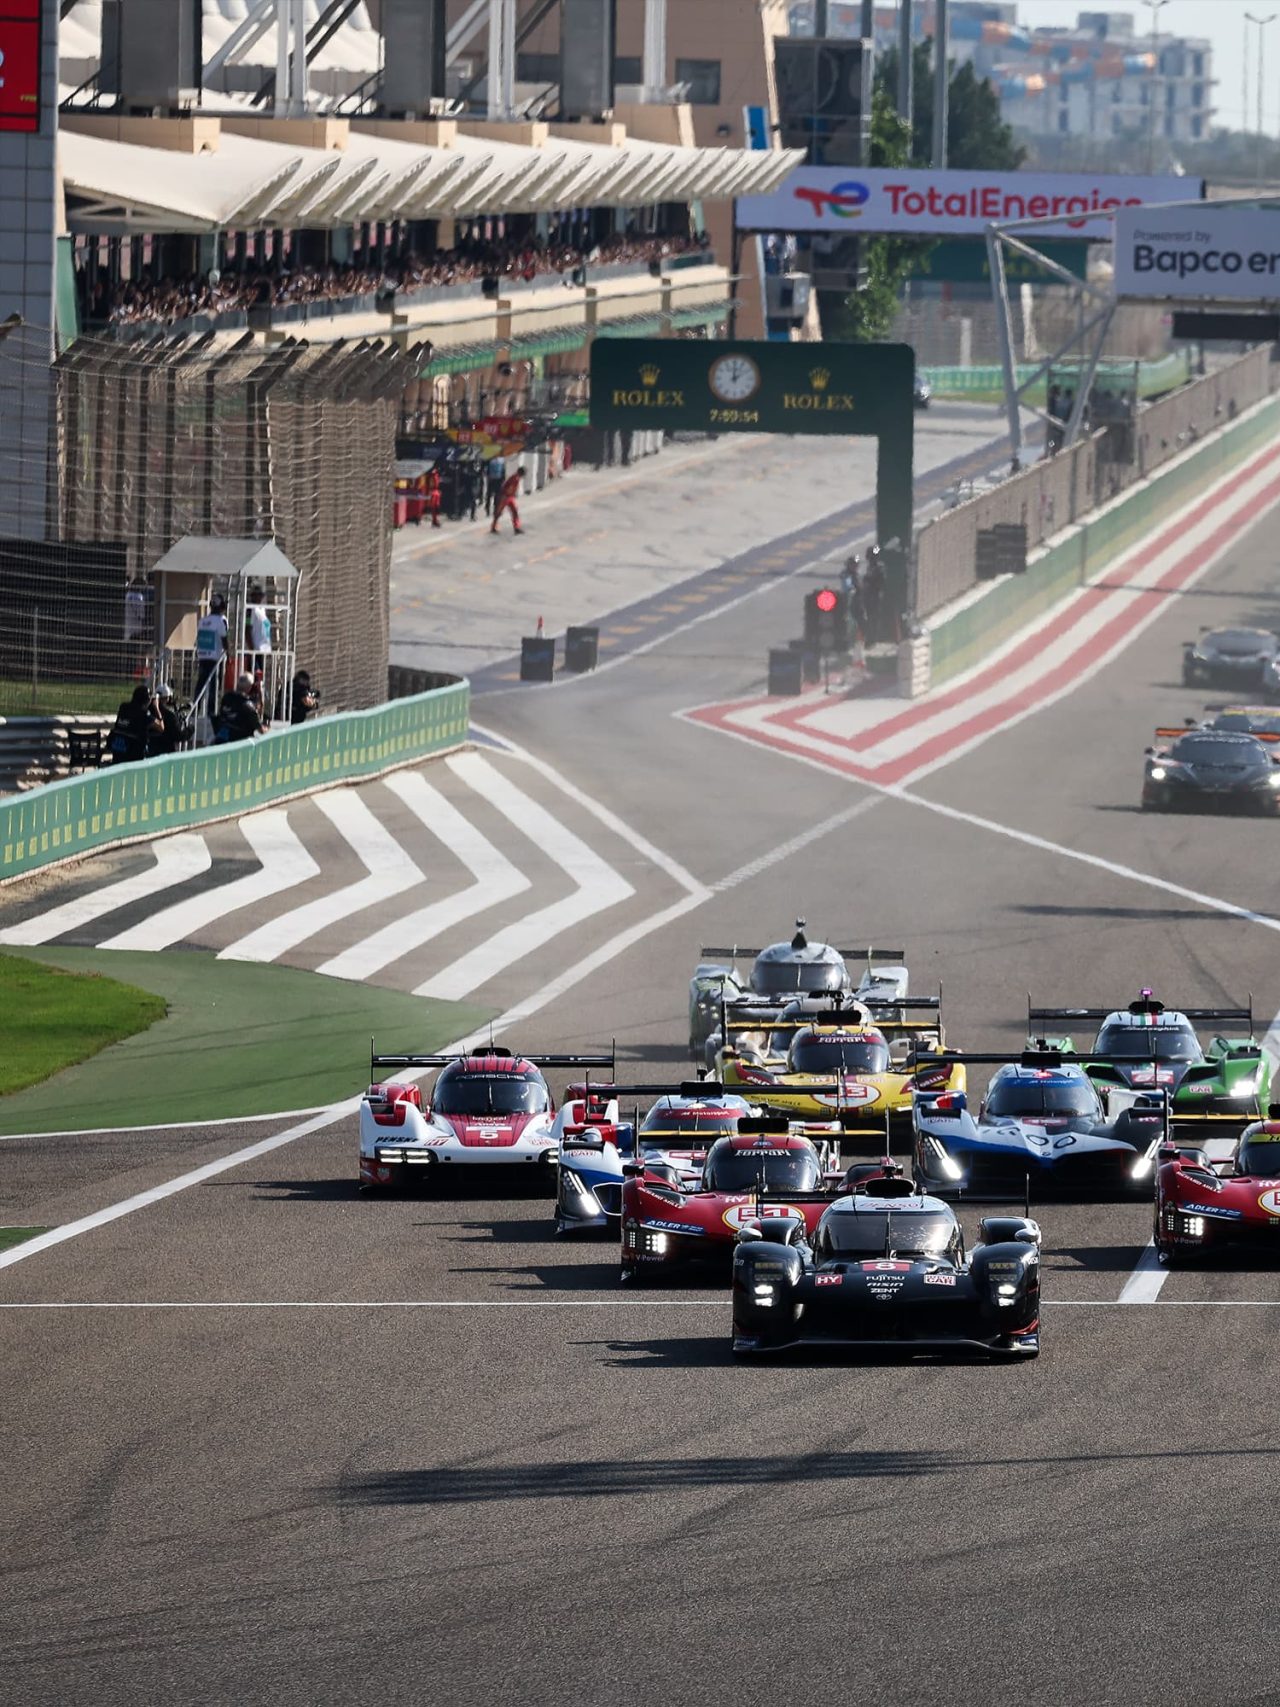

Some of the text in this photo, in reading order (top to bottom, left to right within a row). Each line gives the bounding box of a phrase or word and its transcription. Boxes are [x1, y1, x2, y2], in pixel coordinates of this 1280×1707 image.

[1133, 229, 1212, 244] Powered by
[1133, 245, 1242, 278] Bapco
[612, 390, 685, 408] ROLEX
[783, 393, 855, 411] ROLEX
[455, 1073, 526, 1081] PORSCHE
[479, 1130, 499, 1140] 5
[734, 1149, 791, 1157] Ferrari
[1186, 1203, 1219, 1214] ADLER
[741, 1208, 783, 1220] 51
[646, 1219, 681, 1230] ADLER
[875, 1262, 896, 1270] 8
[816, 1276, 840, 1285] HY
[866, 1273, 906, 1282] FUJITSU
[926, 1277, 954, 1286] CAR
